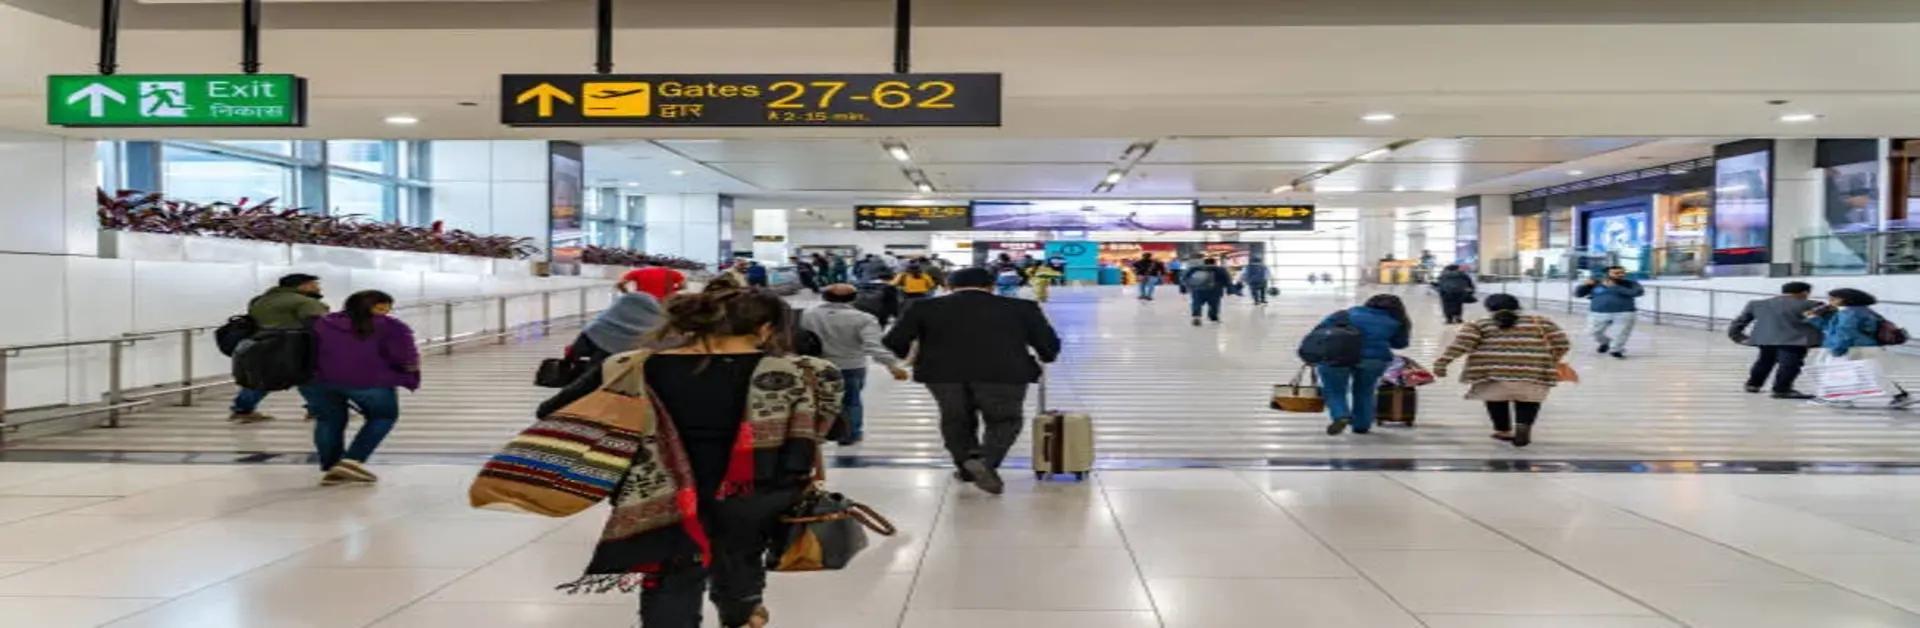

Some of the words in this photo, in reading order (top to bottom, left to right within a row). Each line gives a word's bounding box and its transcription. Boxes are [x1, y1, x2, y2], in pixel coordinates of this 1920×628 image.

[208, 80, 276, 98] Exit
[657, 81, 760, 98] Gates
[767, 80, 955, 109] 27-62
[209, 102, 283, 118] निकास
[658, 103, 704, 118] द्वार
